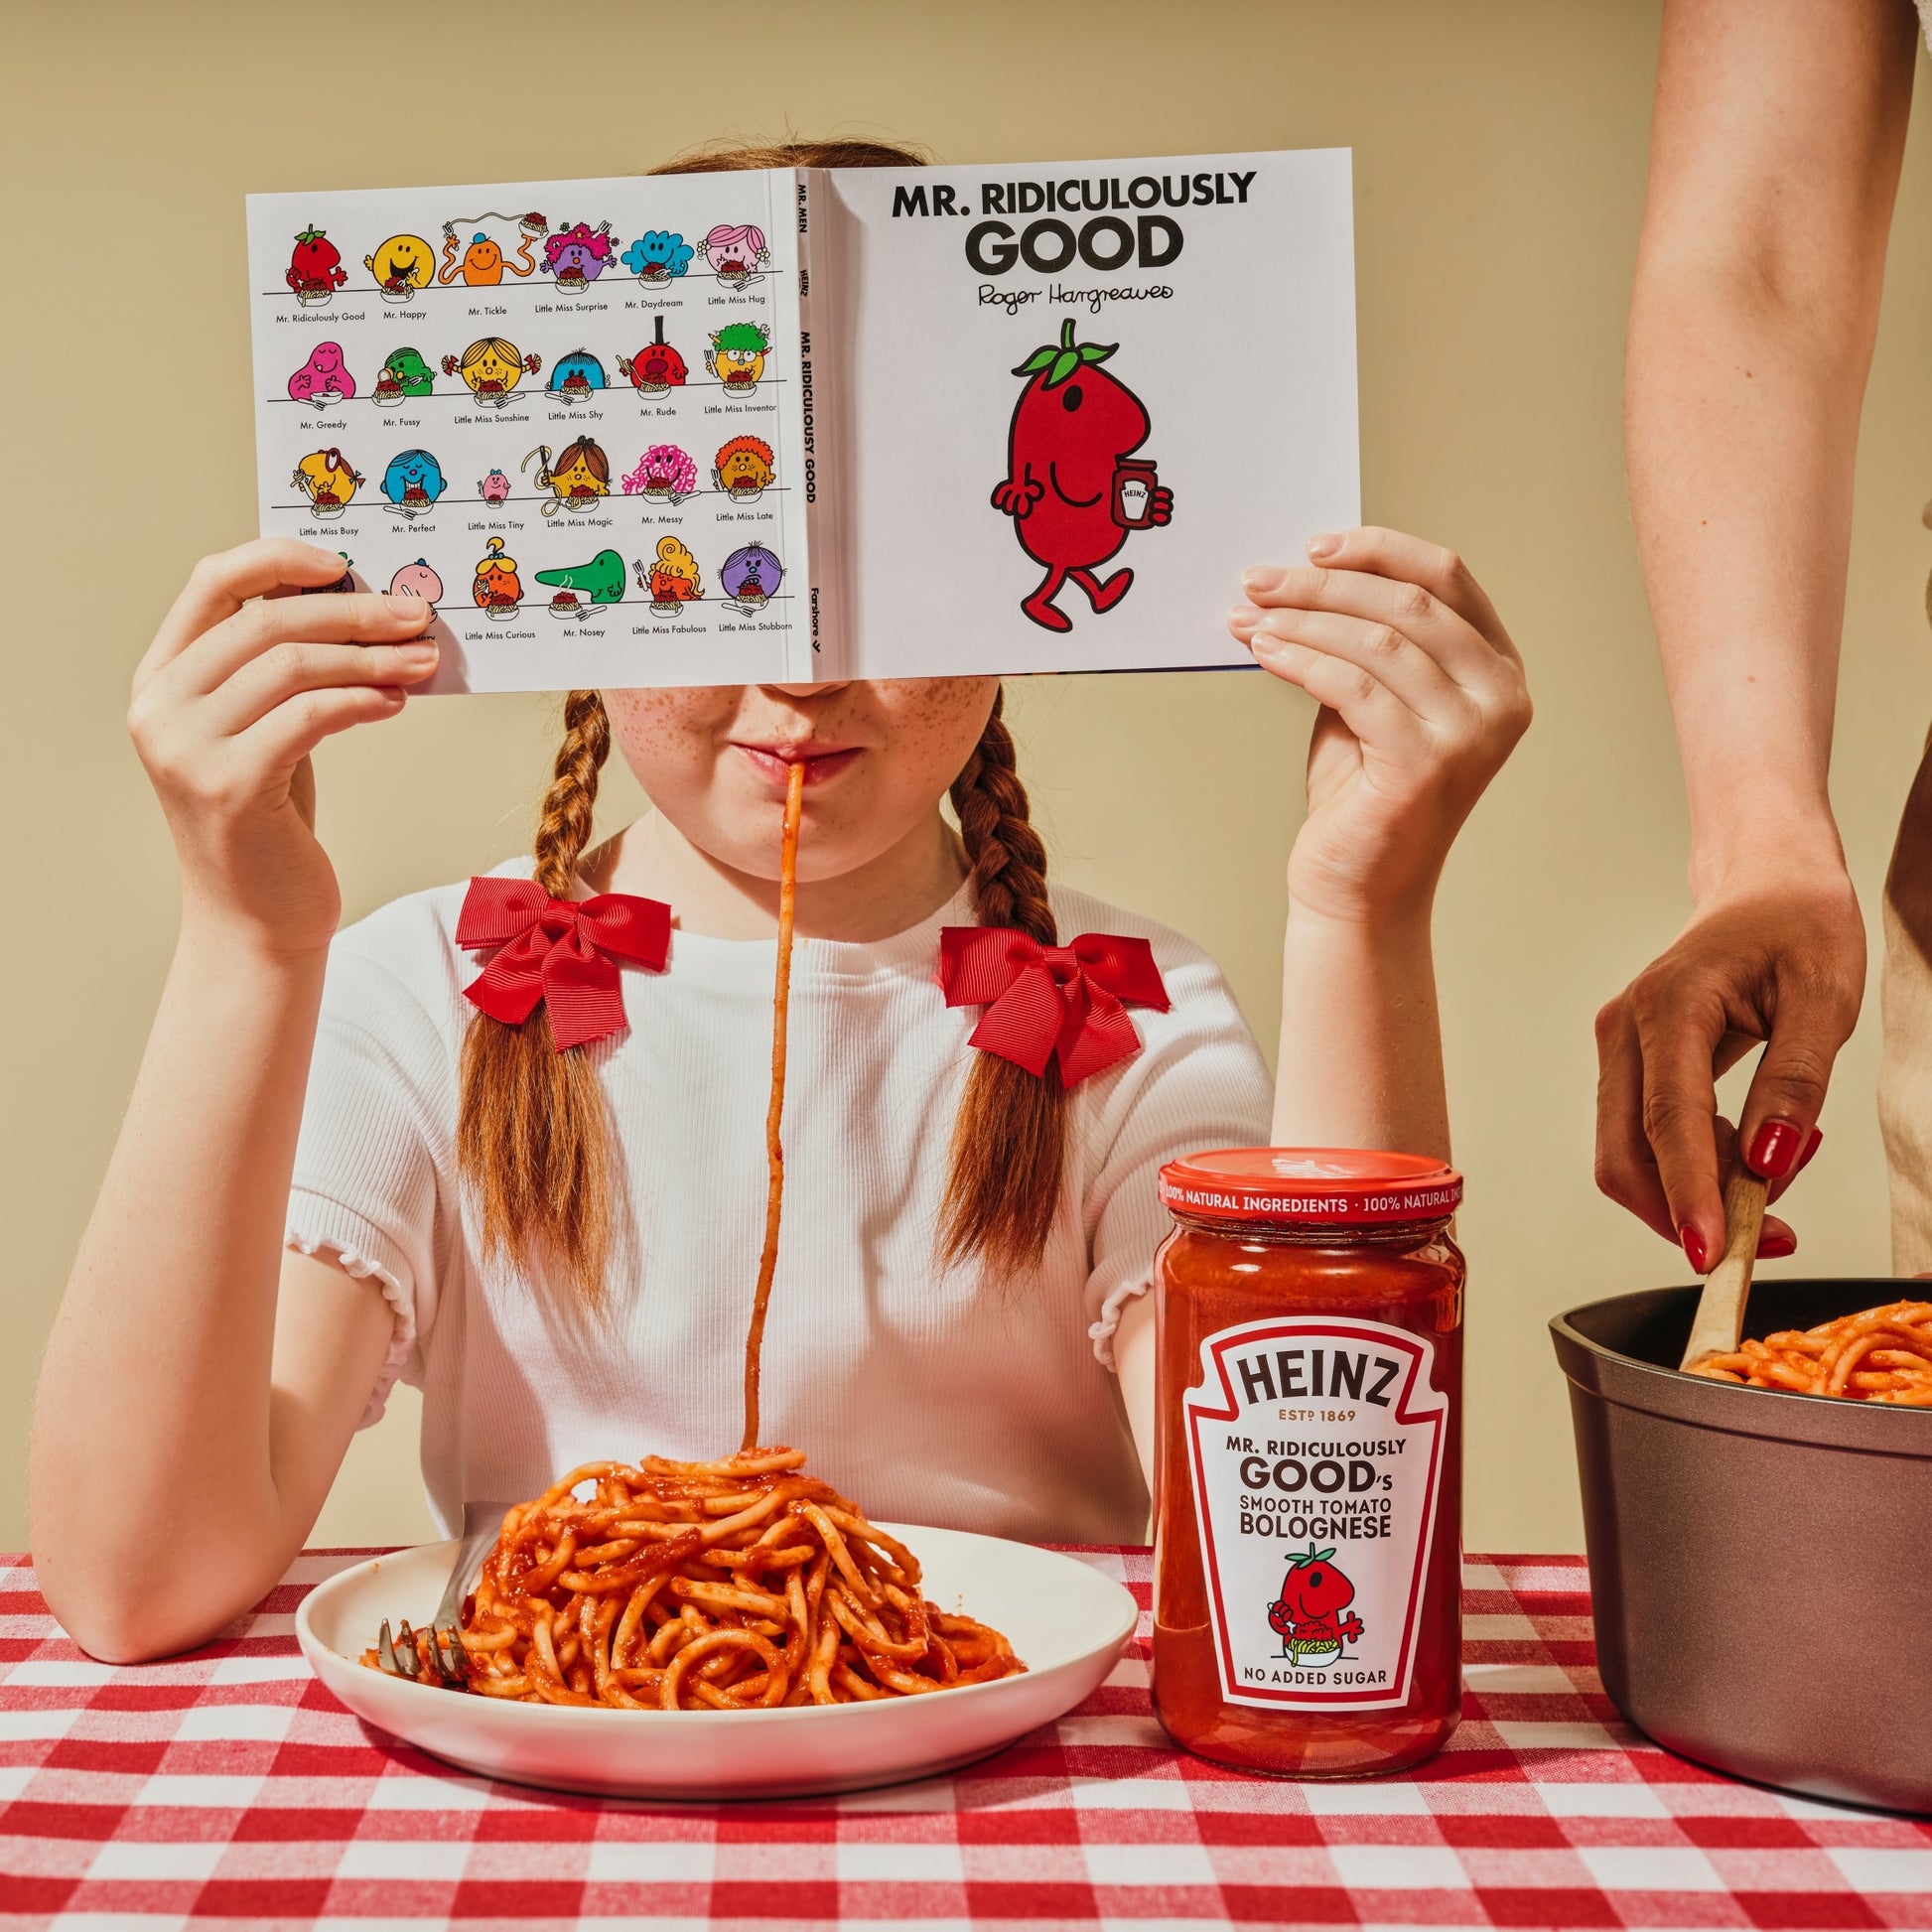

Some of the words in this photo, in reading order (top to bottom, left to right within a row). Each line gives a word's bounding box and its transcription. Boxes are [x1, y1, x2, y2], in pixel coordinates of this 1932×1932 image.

[893, 186, 970, 216] MR.
[982, 172, 1257, 214] RIDICULOUSLY
[965, 214, 1183, 275] GOOD
[800, 270, 809, 297] HEINZ
[641, 299, 682, 309] Daydream
[749, 295, 764, 305] Hug
[979, 284, 1041, 316] Roger
[1049, 284, 1173, 314] Hargreaves
[484, 306, 506, 315] Tickle
[535, 304, 552, 313] Little
[576, 303, 608, 313] Surprise
[293, 313, 339, 323] Ridiculously
[342, 312, 364, 321] Good
[400, 311, 426, 320] Happy
[800, 332, 810, 358] MR.
[802, 361, 814, 455] RIDICULOUSY
[495, 413, 529, 422] Sunshine
[589, 410, 603, 420] Shy
[317, 420, 346, 430] Greedy
[400, 418, 420, 427] Fussy
[805, 459, 816, 503] GOOD
[508, 521, 524, 530] Tiny
[588, 518, 613, 527] Magic
[300, 527, 317, 536] Little
[341, 527, 358, 536] Busy
[811, 588, 820, 635] Farshore
[759, 621, 792, 630] Stubborn
[466, 631, 483, 640] Little
[580, 628, 605, 637] Nosey
[1186, 1189, 1238, 1209] NATURAL
[1243, 1196, 1347, 1212] INGREDIENTS
[1363, 1196, 1400, 1212] 100%
[1404, 1189, 1450, 1208] NATURAL
[1236, 1349, 1399, 1407] HEINZ
[1320, 1410, 1355, 1422] 1869
[1226, 1436, 1259, 1454] MR.
[1267, 1439, 1407, 1456] RIDICULOUSLY
[1240, 1495, 1313, 1514] SMOOTH
[1320, 1498, 1391, 1514] TOMATO
[1240, 1514, 1391, 1539] BOLOGNESE
[1244, 1667, 1266, 1682] NO
[1272, 1670, 1326, 1685] ADDED
[1333, 1671, 1387, 1685] SUGAR
